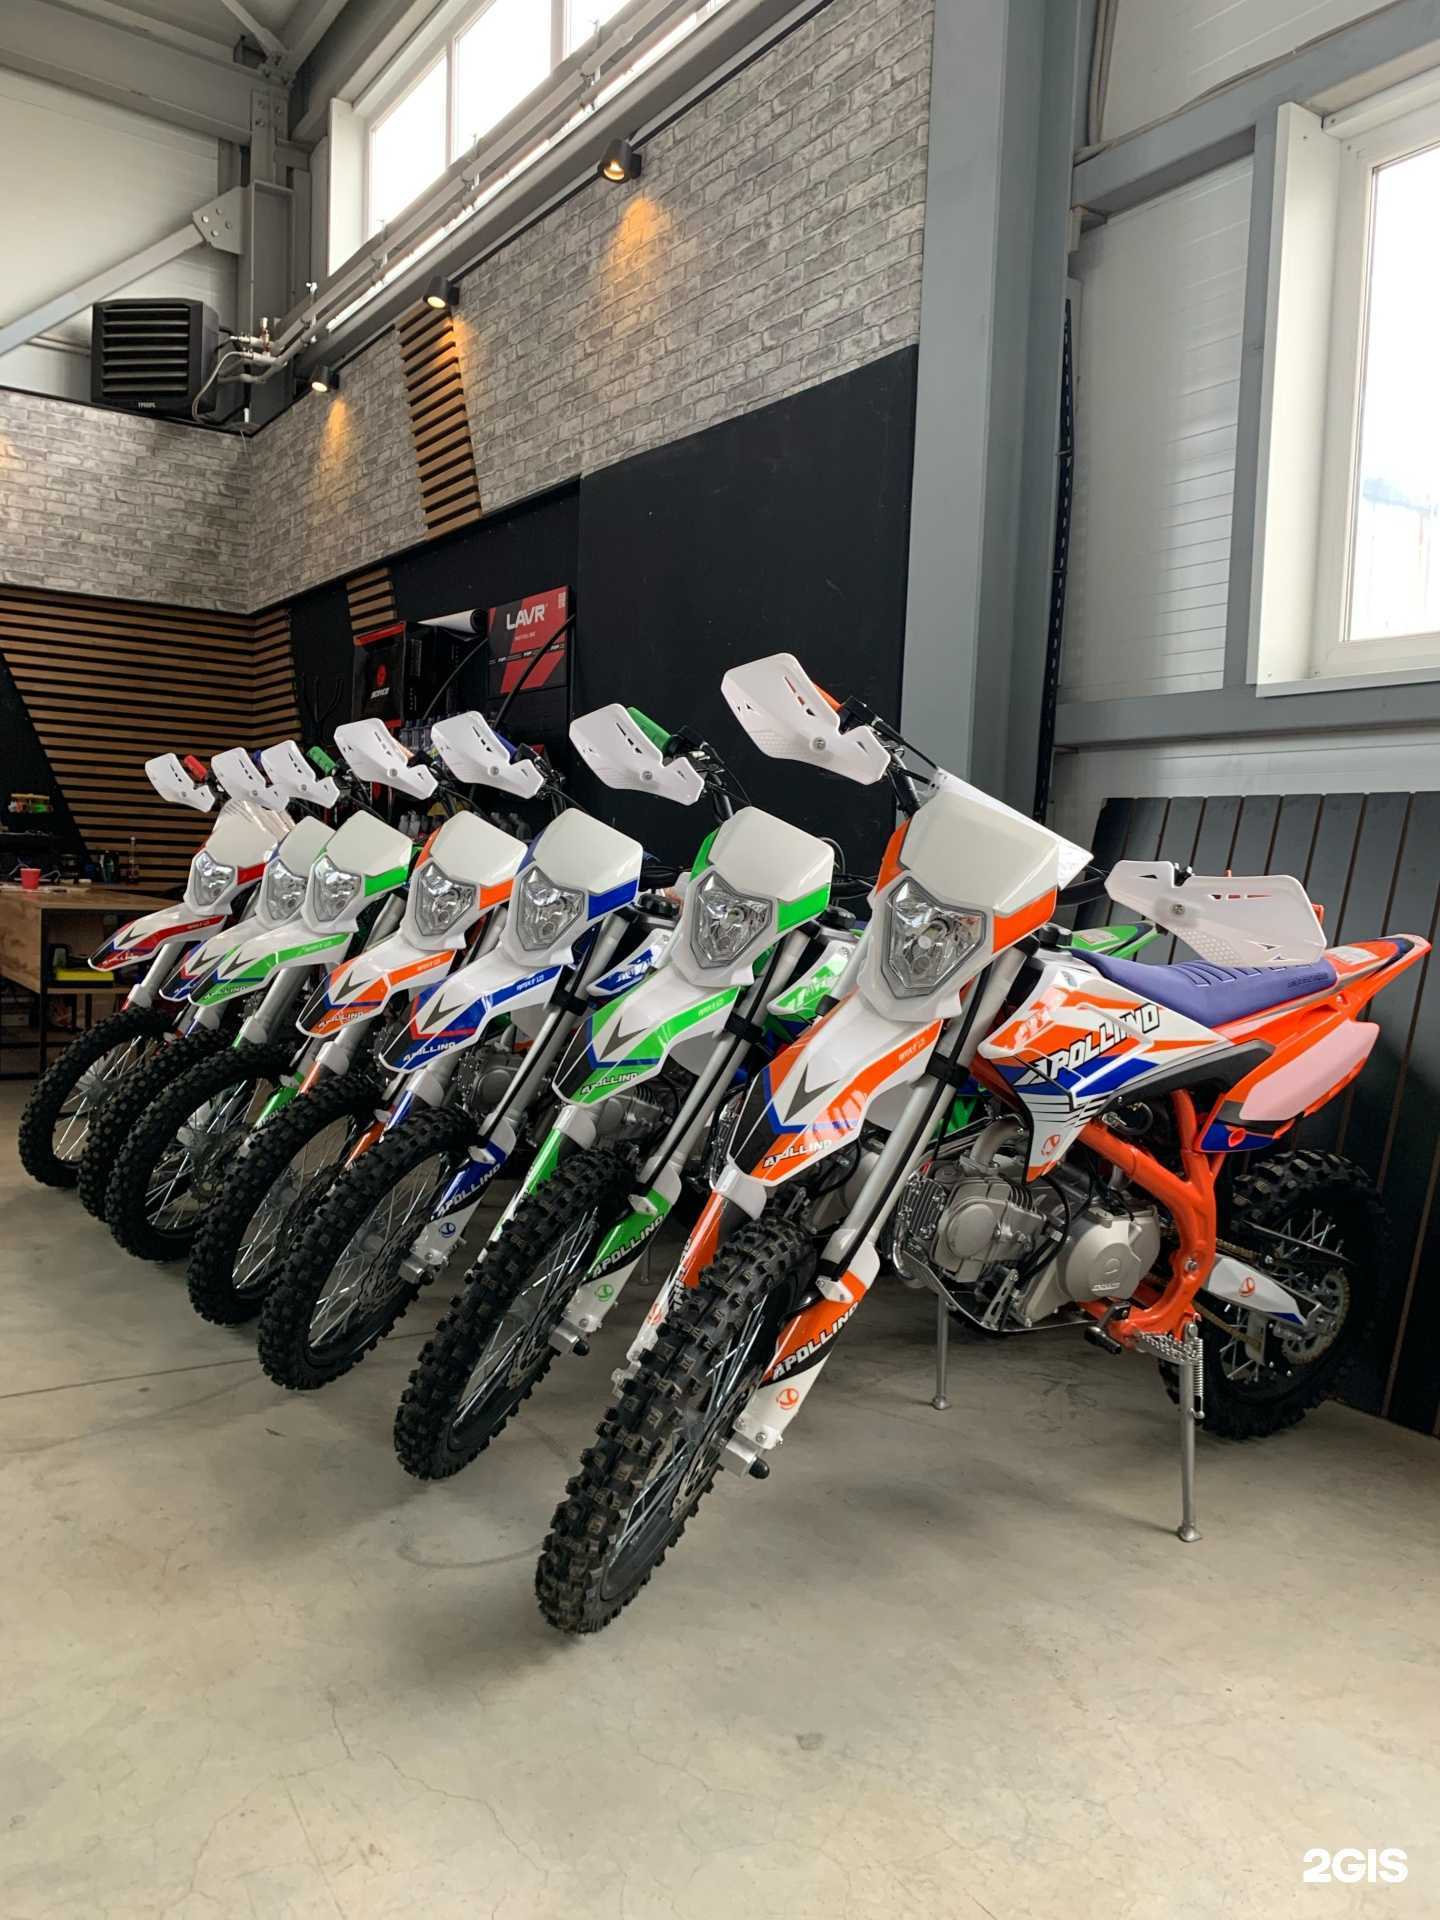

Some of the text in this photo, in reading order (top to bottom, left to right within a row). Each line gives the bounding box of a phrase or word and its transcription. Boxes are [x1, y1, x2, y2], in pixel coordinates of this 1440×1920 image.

[506, 604, 545, 630] LAVR
[592, 1214, 665, 1279] APOLLINO
[772, 1301, 859, 1381] APOLLINO
